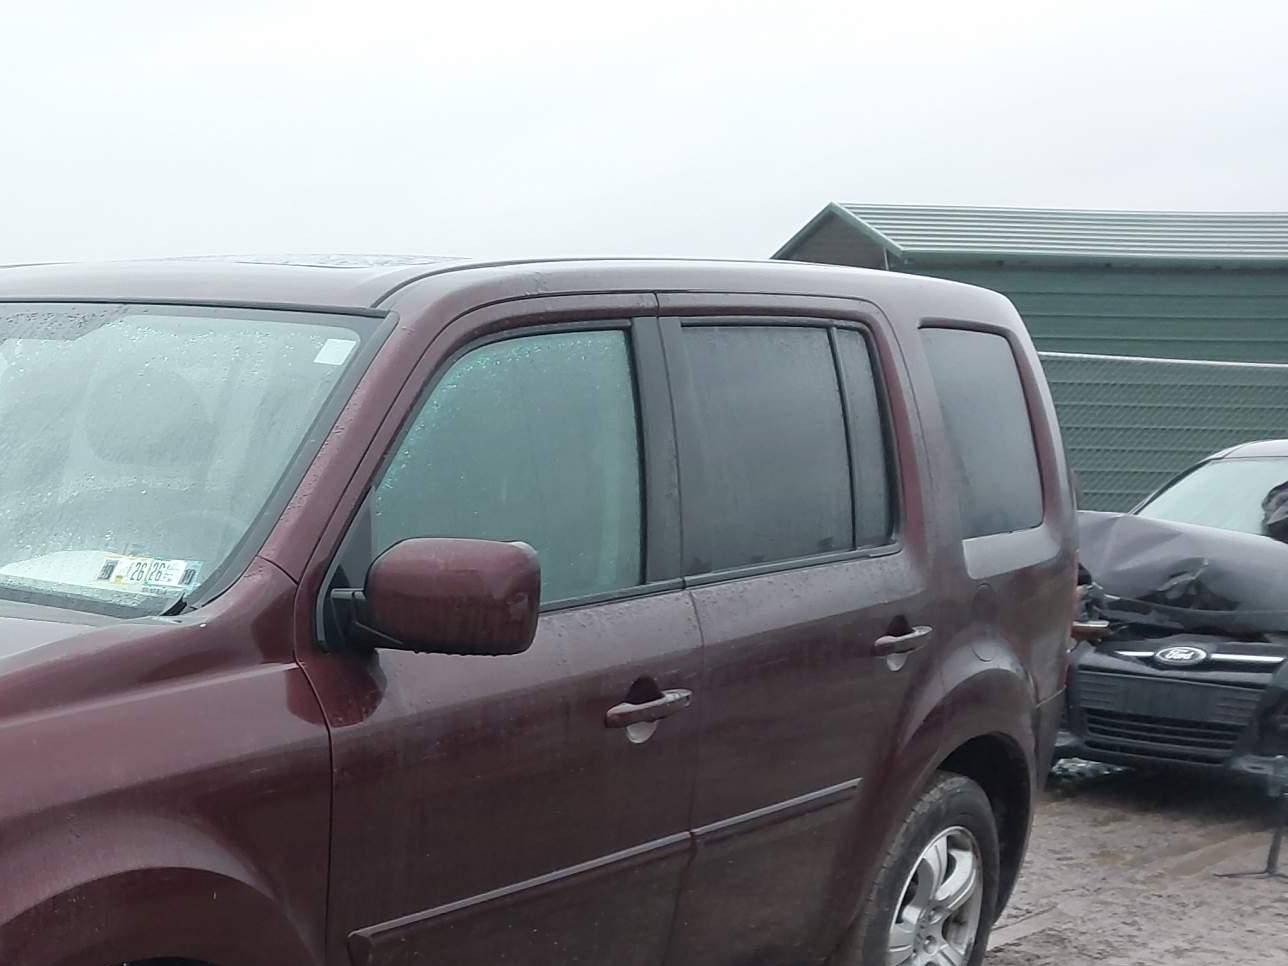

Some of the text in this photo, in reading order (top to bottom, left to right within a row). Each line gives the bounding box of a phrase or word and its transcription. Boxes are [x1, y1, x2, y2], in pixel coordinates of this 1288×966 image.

[129, 562, 148, 582] 26
[148, 562, 166, 582] 26
[1165, 649, 1195, 660] Ford
